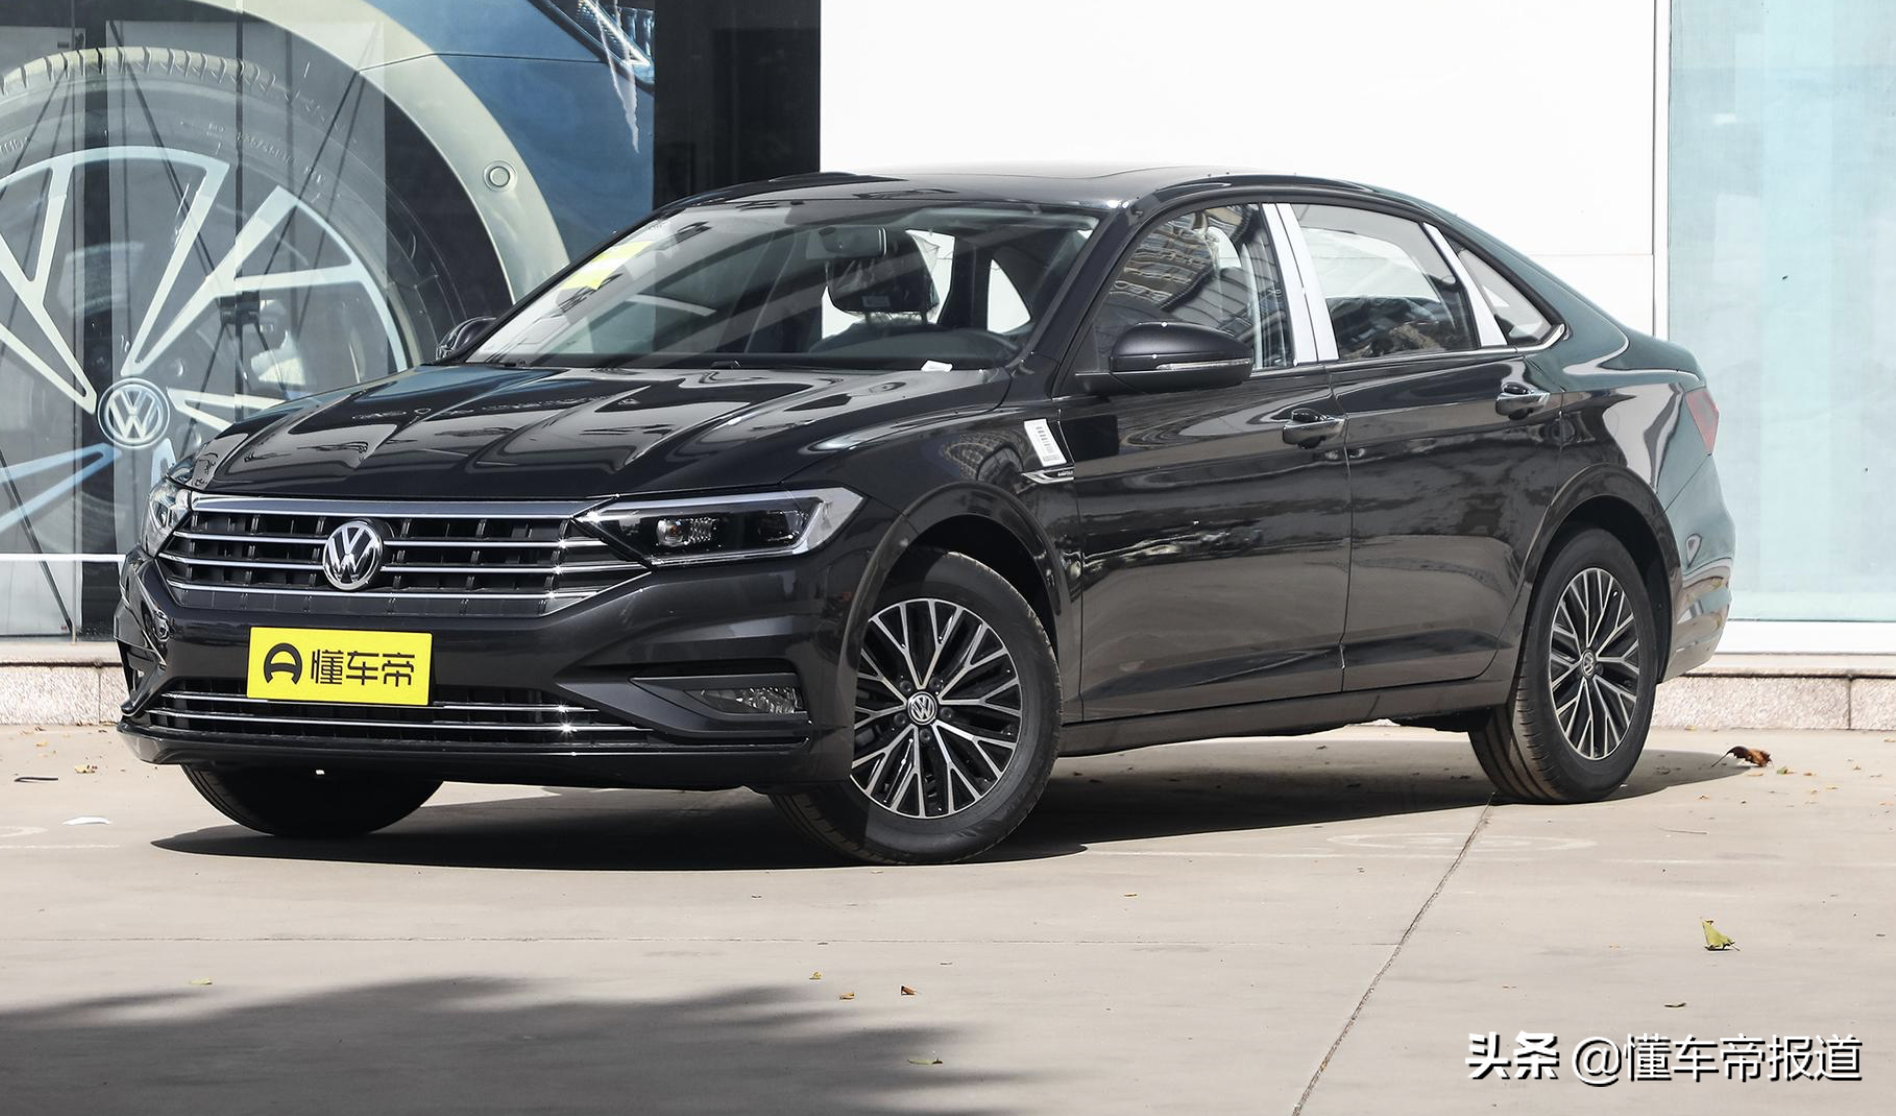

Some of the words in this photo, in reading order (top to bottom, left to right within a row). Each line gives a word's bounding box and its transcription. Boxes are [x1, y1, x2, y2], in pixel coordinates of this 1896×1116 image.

[103, 383, 165, 444] VW
[323, 520, 380, 591] VW
[310, 648, 416, 688] 懂车帝
[910, 693, 936, 724] VW
